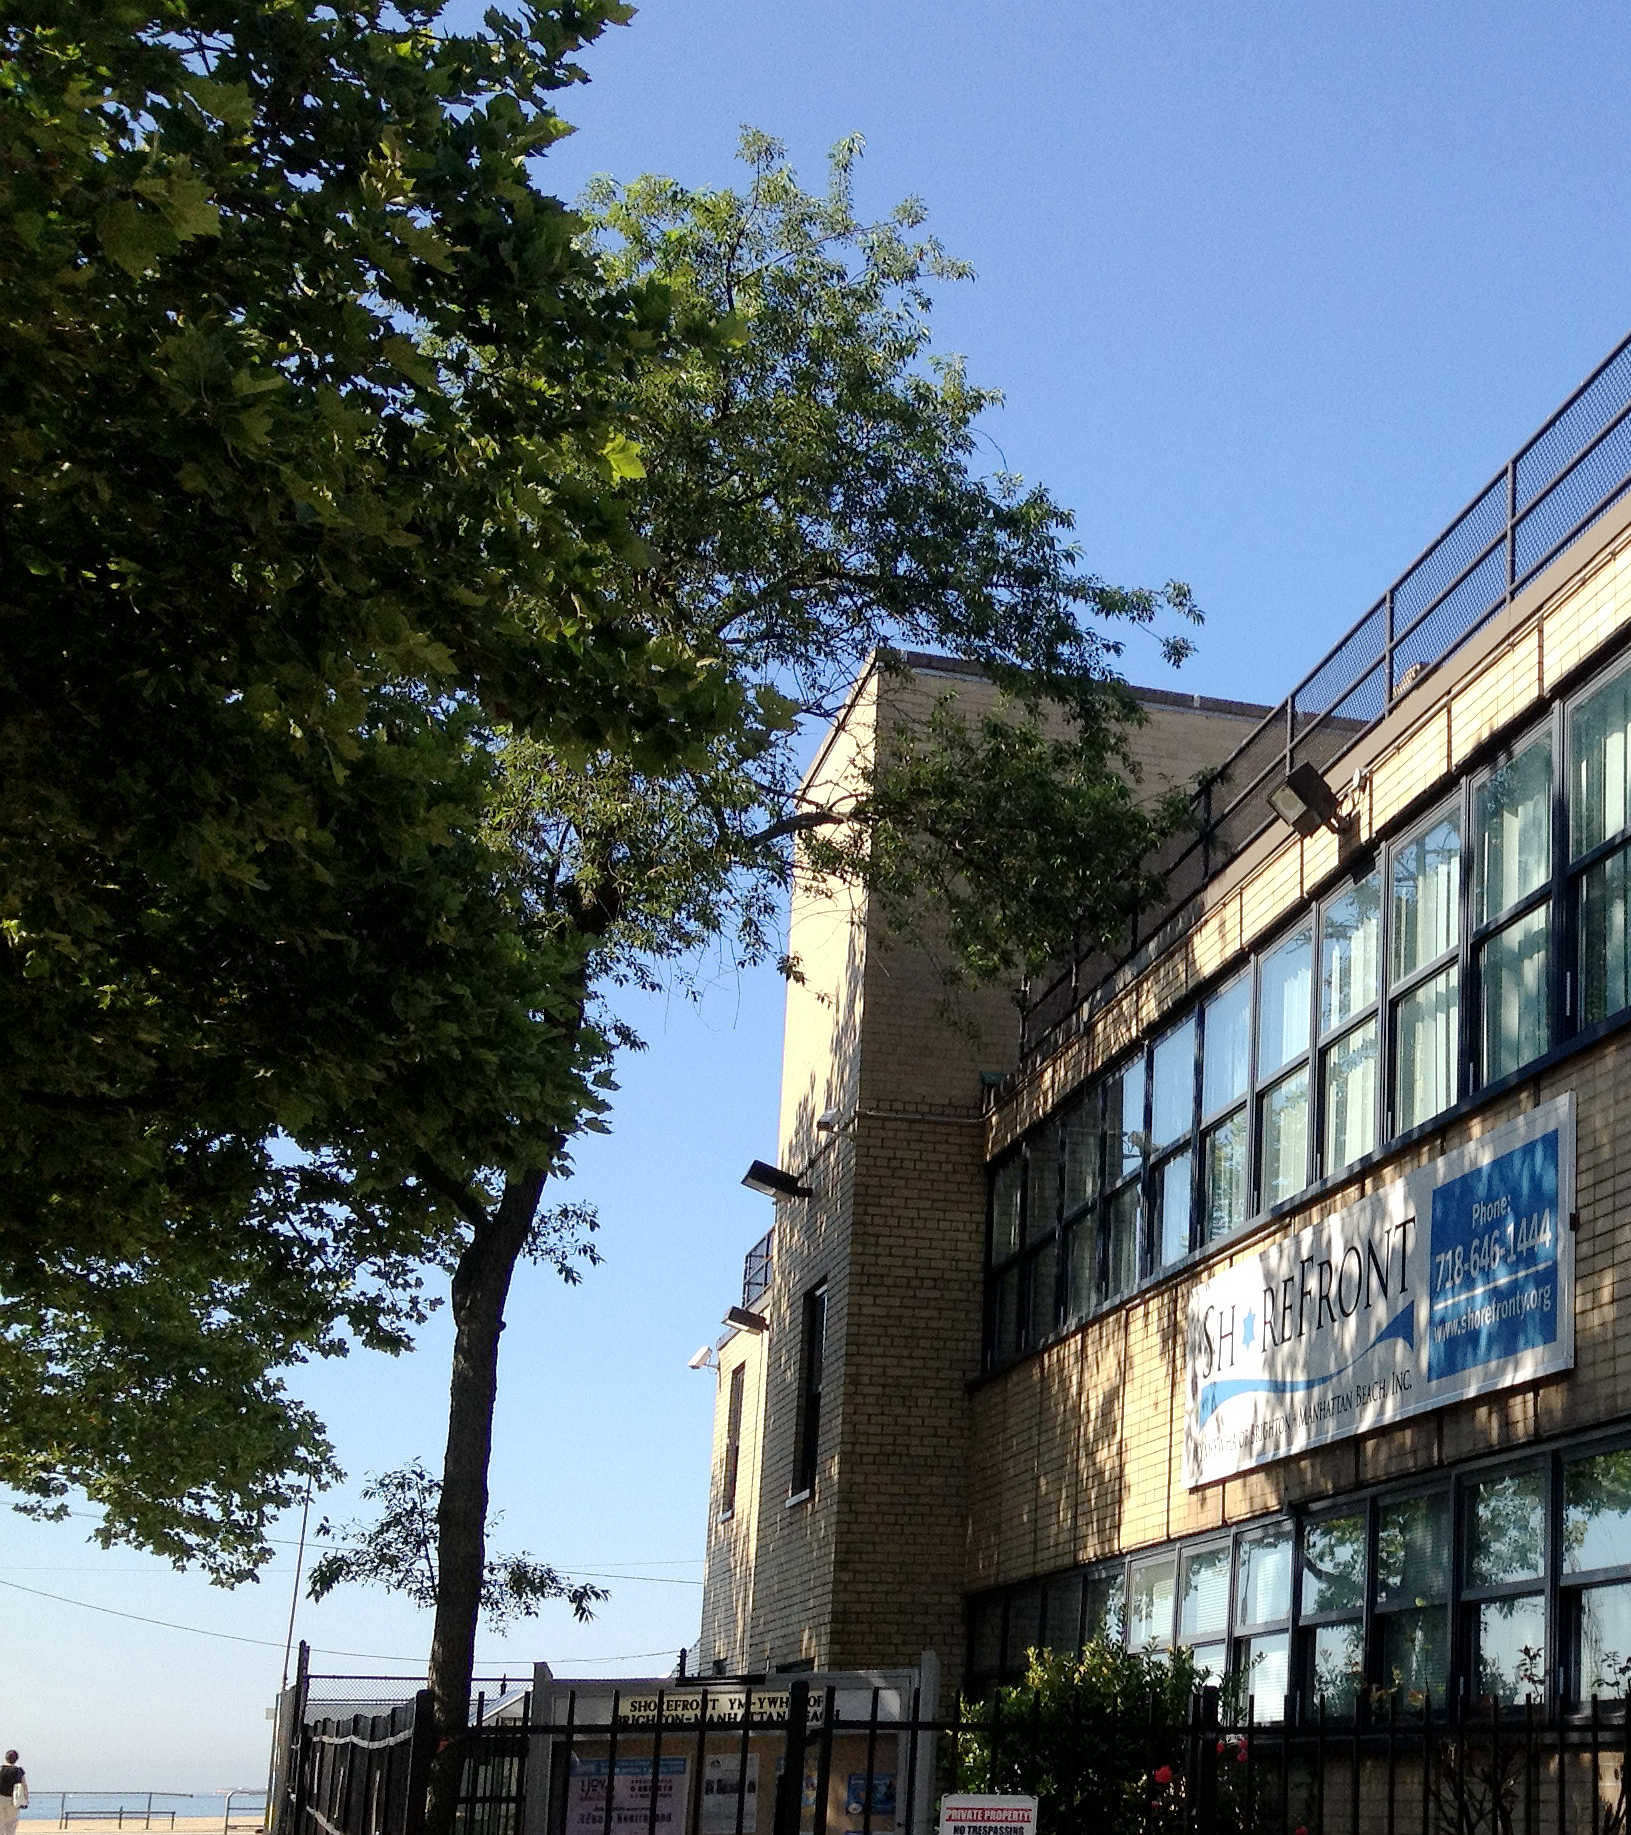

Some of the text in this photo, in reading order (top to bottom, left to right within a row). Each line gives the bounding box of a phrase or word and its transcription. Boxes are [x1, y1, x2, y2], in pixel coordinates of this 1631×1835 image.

[1472, 1193, 1511, 1232] Phone:
[1434, 1207, 1552, 1293] 718-646-1444
[1433, 1283, 1552, 1345] www.shorefronty.org
[1298, 1391, 1352, 1427] MANHATTAN
[629, 1698, 719, 1713] SHOEFROT
[729, 1696, 799, 1710] YM-YWH
[945, 1809, 983, 1821] PRIVATE
[953, 1825, 965, 1835] NO
